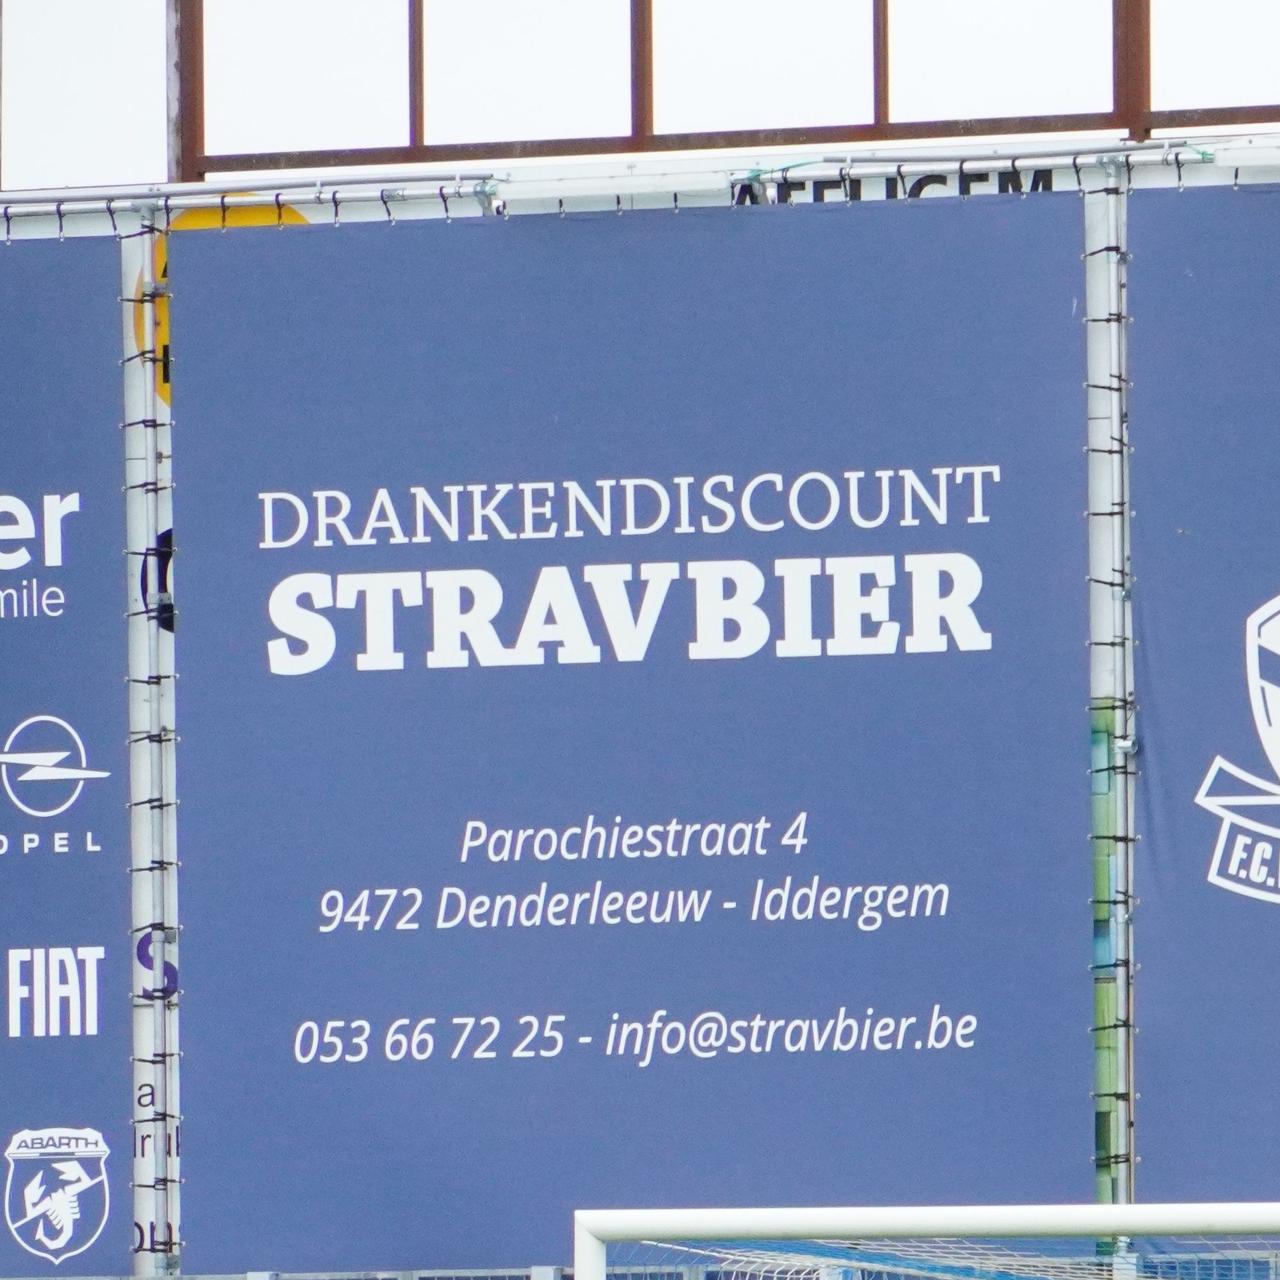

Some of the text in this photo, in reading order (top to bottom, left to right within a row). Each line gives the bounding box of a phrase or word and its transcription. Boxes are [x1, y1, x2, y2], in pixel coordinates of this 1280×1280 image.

[259, 465, 1000, 548] DRANKENDISCOUNT
[267, 553, 992, 675] STRAVBIER
[460, 812, 809, 862] Parochiestraat 4
[318, 888, 423, 932] 9472
[436, 881, 712, 928] Denderleeuw
[751, 875, 949, 931] Iddergem
[8, 946, 105, 1037] FIAT
[294, 1020, 369, 1063] 053
[384, 1018, 435, 1060] 66
[451, 1017, 499, 1058] 72
[512, 1015, 565, 1057] 25
[605, 1005, 978, 1067] info@stravbier.be
[17, 1136, 99, 1150] ABARTH
